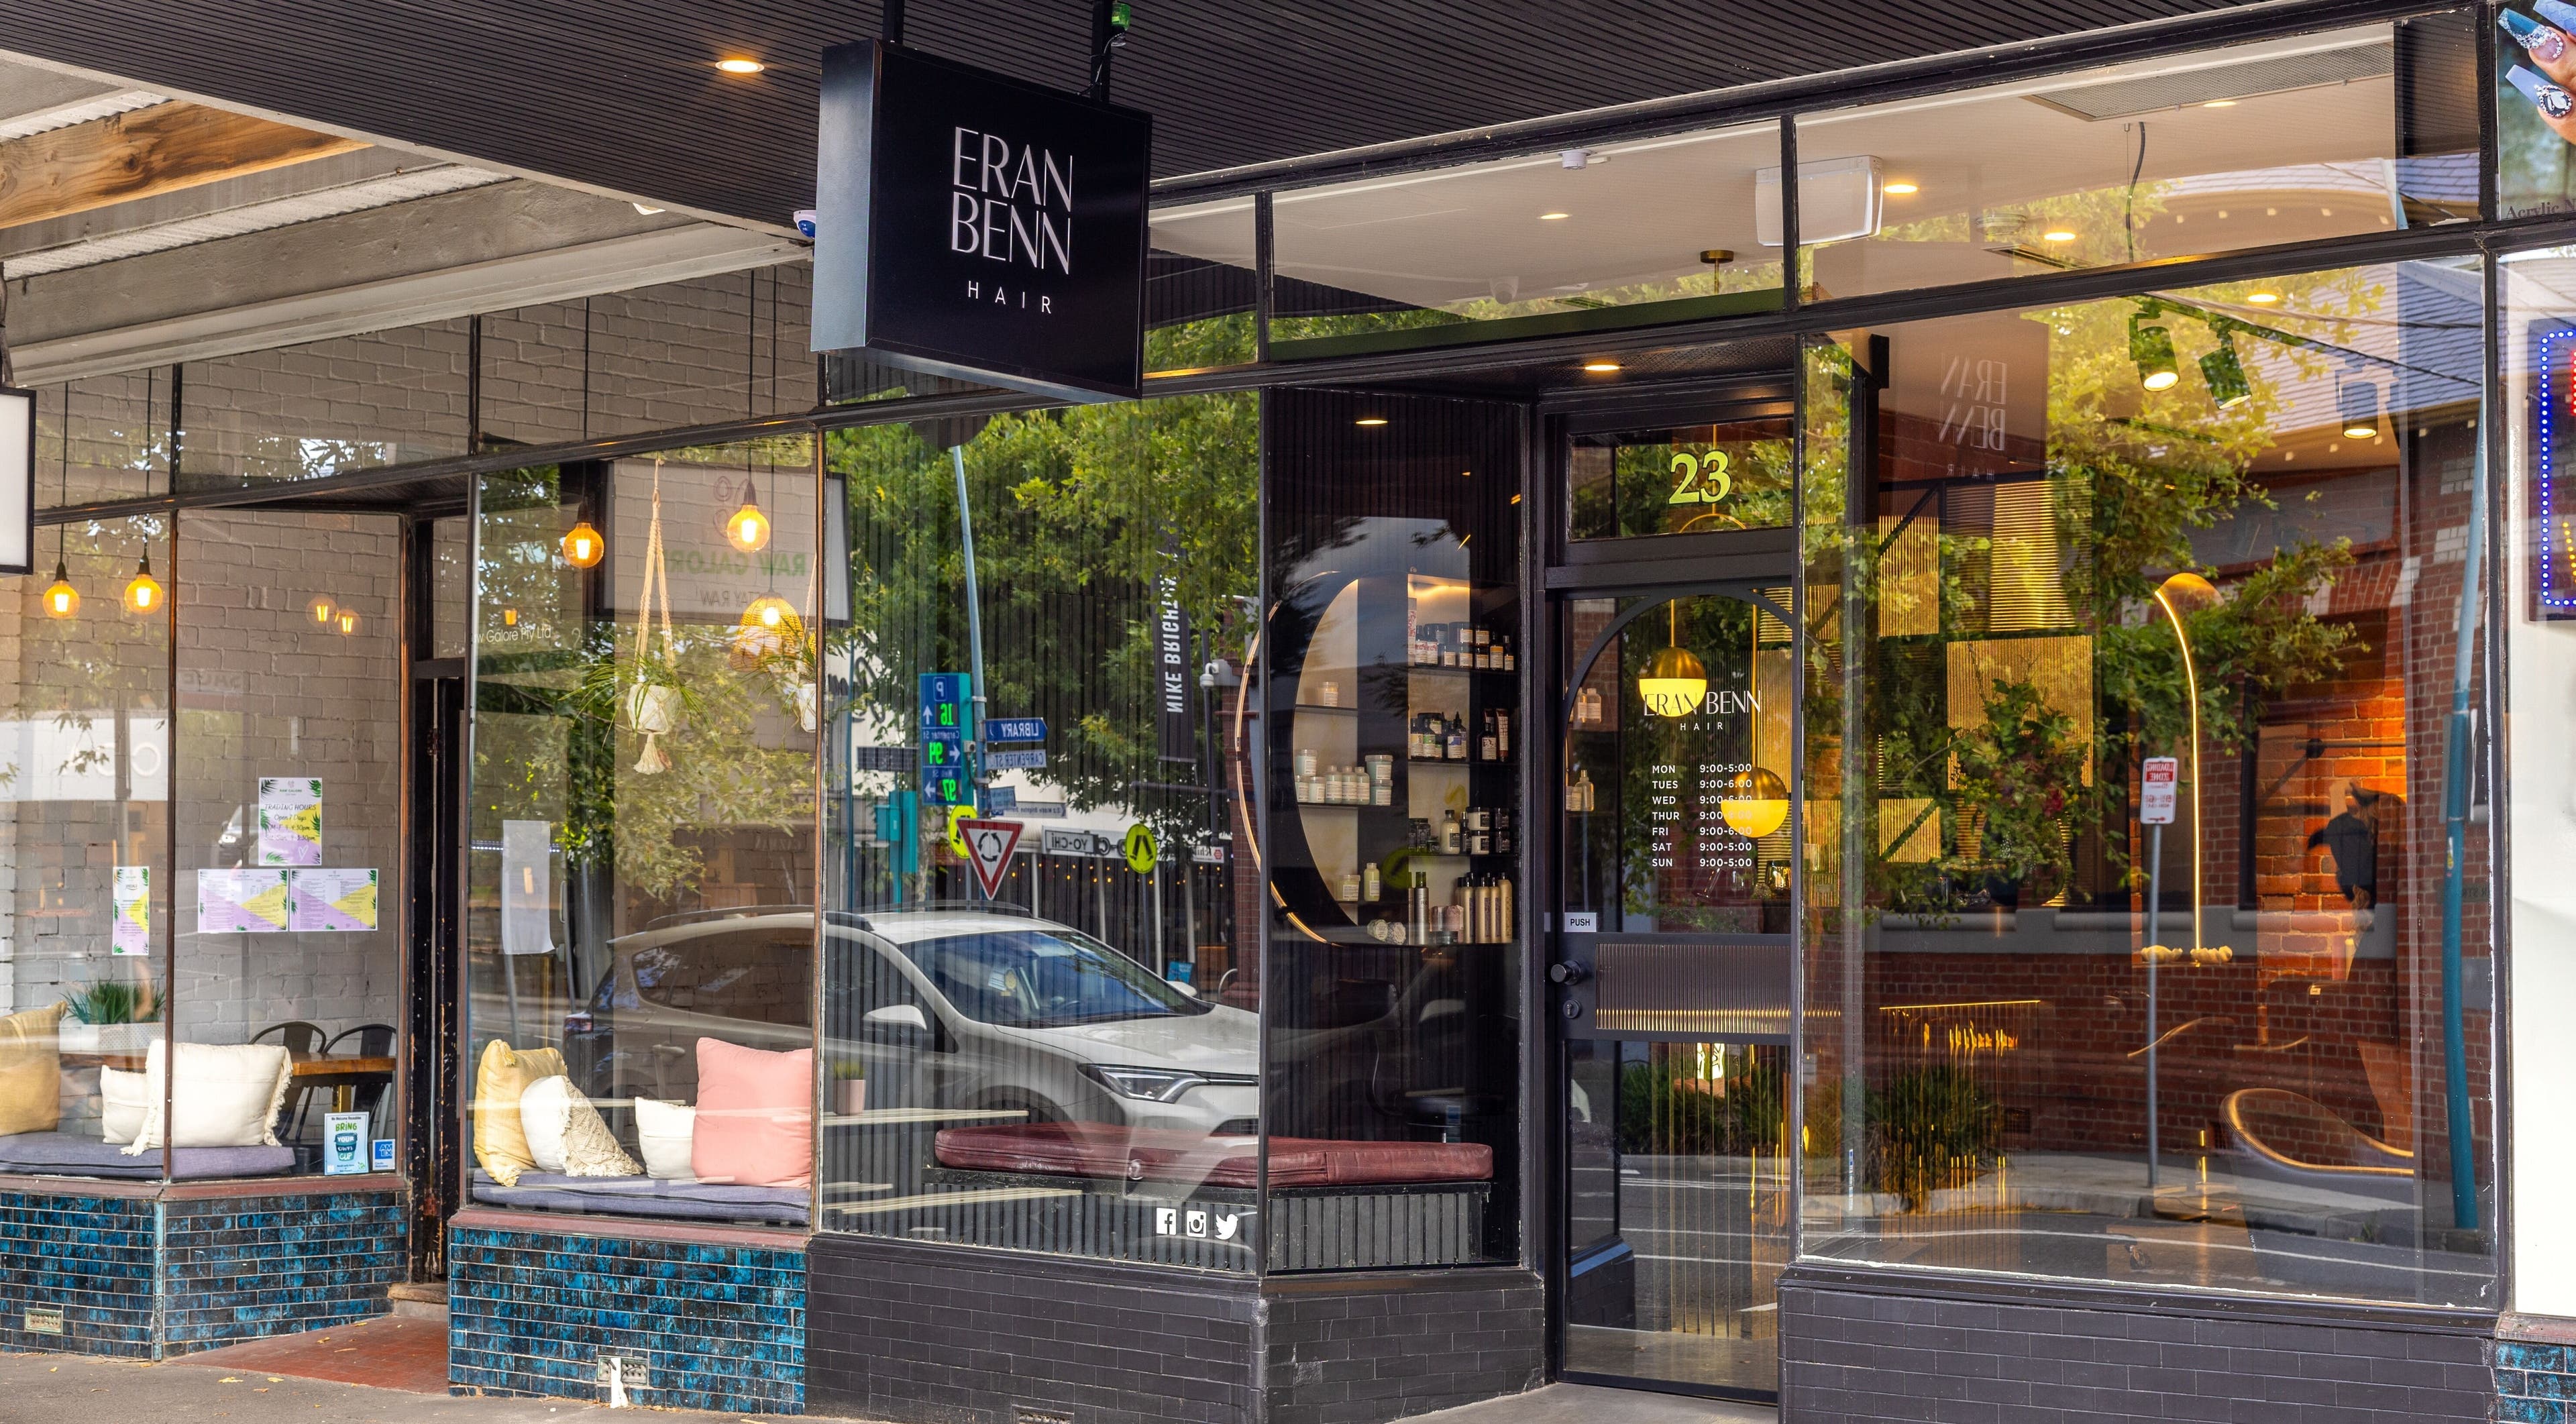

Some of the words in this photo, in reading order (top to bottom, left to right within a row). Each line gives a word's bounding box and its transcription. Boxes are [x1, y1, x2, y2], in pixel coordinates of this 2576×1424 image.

[953, 126, 1073, 212] ERAN
[951, 191, 1071, 275] BENN
[968, 280, 1052, 314] HAIR
[1668, 449, 1731, 504] 23
[486, 629, 519, 643] Galore
[537, 624, 551, 639] Ltd
[1644, 692, 1698, 716] ERAN
[1706, 690, 1761, 714] BENN
[1679, 722, 1724, 731] HAIR
[1652, 765, 1676, 773] MON
[1699, 764, 1752, 773] 9:00-5:00
[1652, 781, 1678, 789] TUES
[1699, 780, 1752, 789] 9:00-6:00
[1652, 796, 1676, 805] WED
[1652, 812, 1680, 820] THUR
[1652, 828, 1668, 836] FRI
[1699, 827, 1752, 835] 9:00-6:00
[1652, 843, 1672, 851] SAT
[1699, 842, 1752, 851] 9:00-5:00
[1652, 859, 1672, 867] SUN
[1699, 858, 1752, 866] 9:00-5:00
[1570, 918, 1590, 926] PUSH
